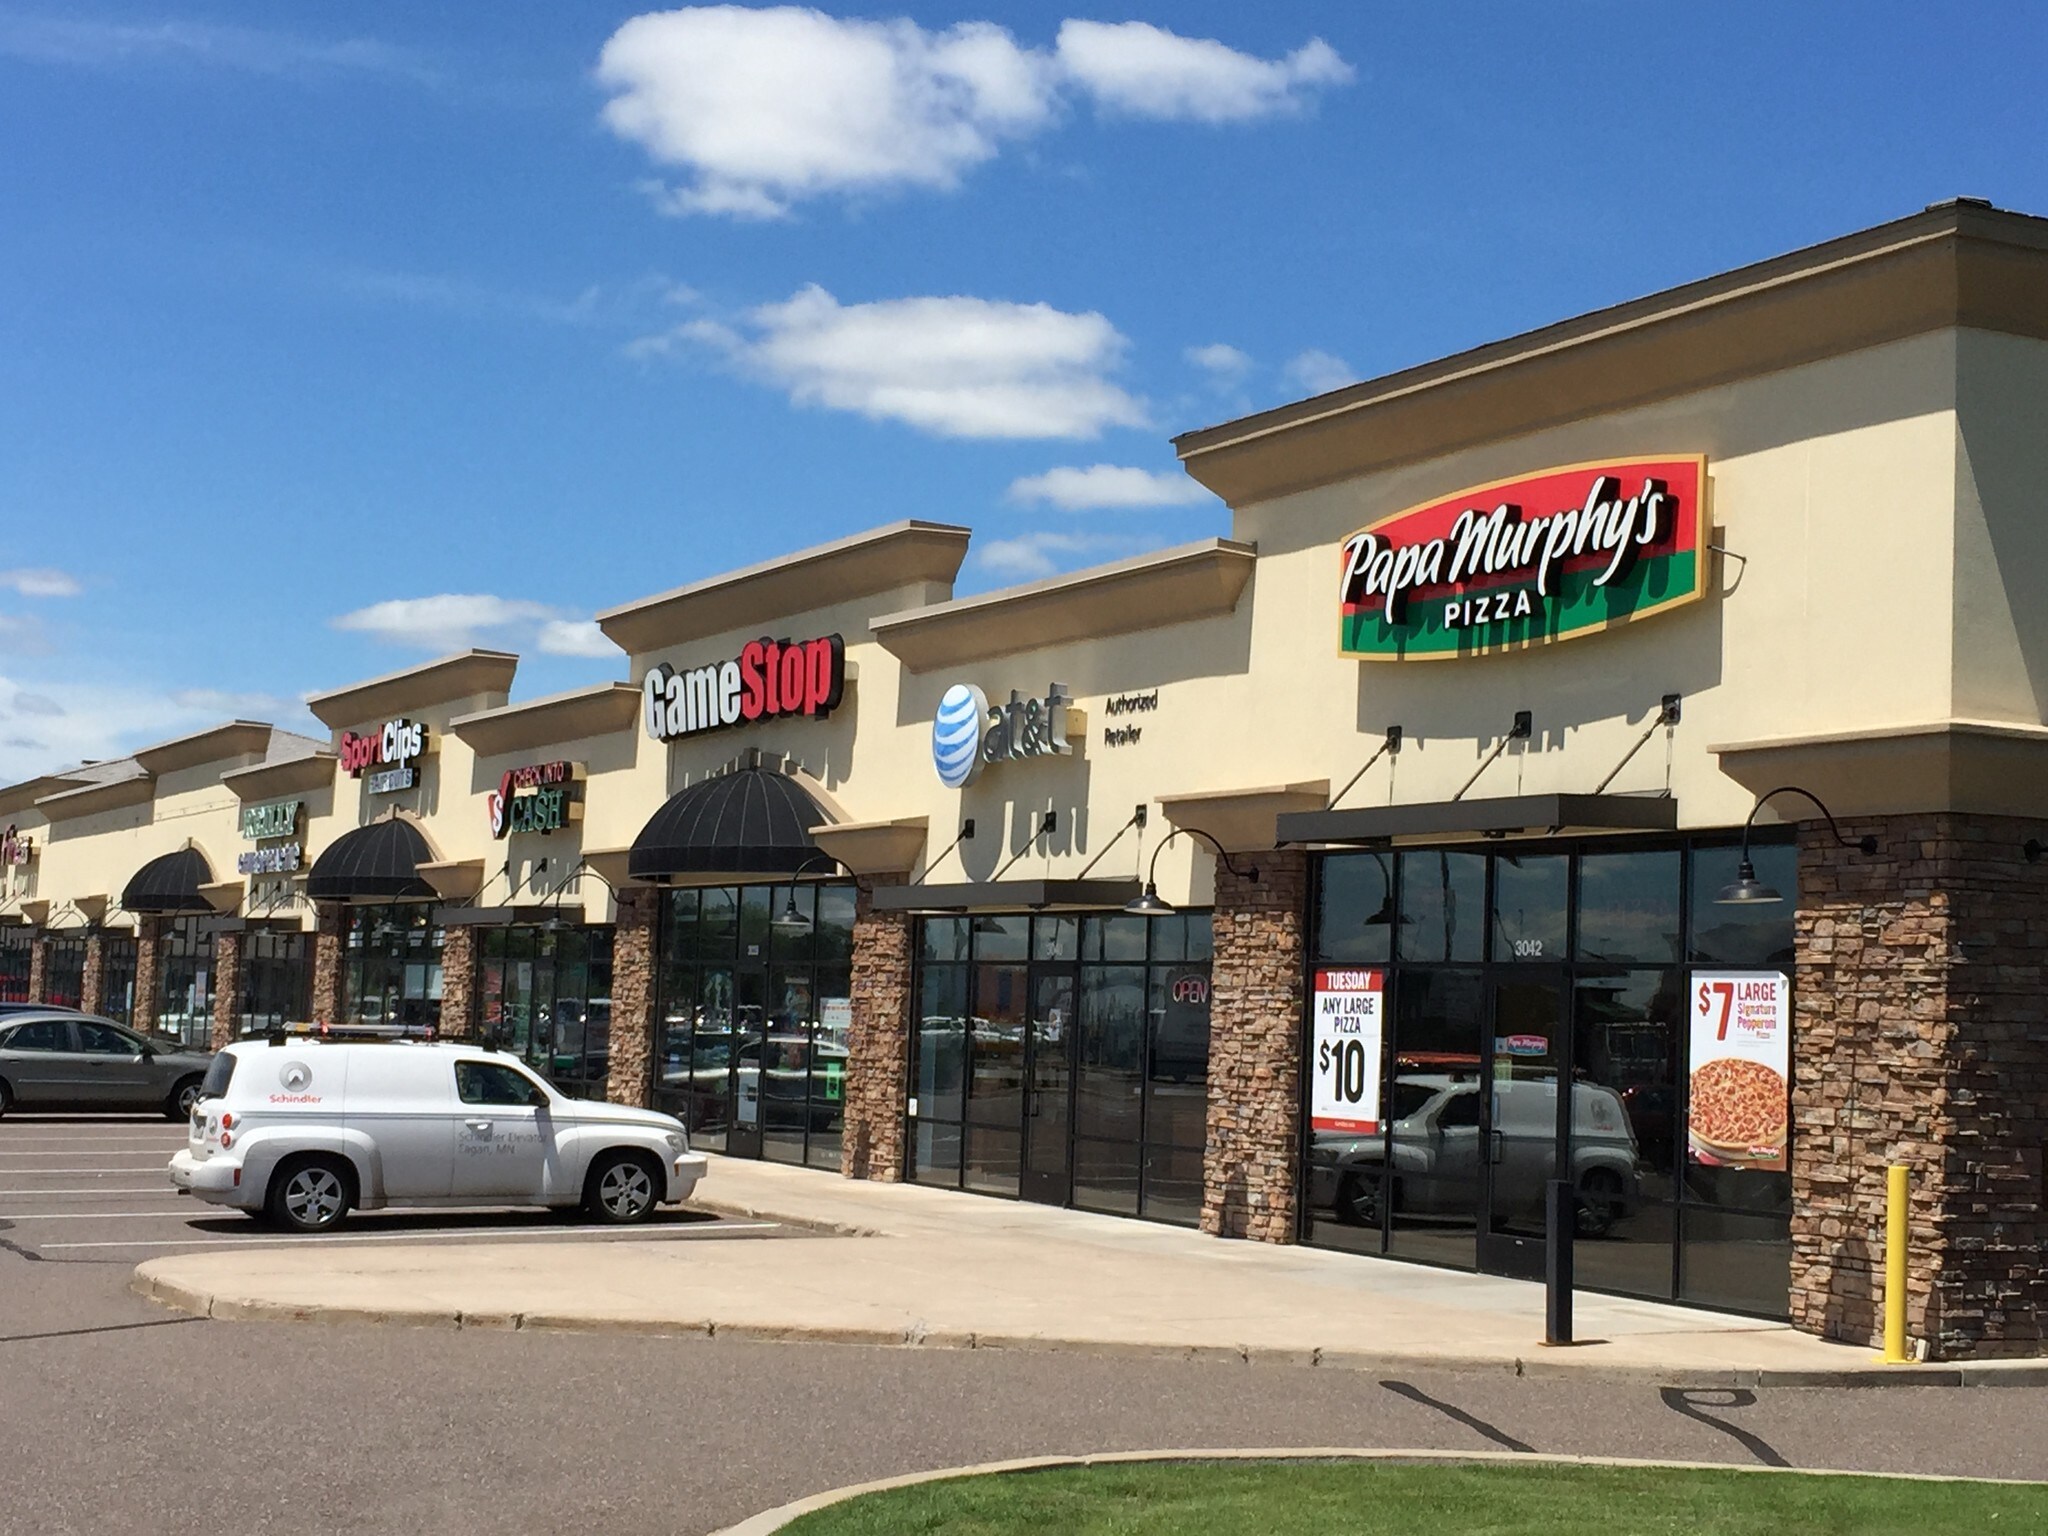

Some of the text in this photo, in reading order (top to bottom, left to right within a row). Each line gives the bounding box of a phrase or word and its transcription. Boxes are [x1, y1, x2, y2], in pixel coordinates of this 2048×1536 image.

[1340, 476, 1664, 624] Papa Murphy's
[1444, 589, 1531, 629] PIZZA
[644, 636, 832, 740] GameStop
[1105, 689, 1158, 716] Authorized
[983, 682, 1070, 763] at&t
[1104, 723, 1142, 748] Retailer
[514, 761, 564, 789] CHECK INTO
[1515, 939, 1543, 956] 3042
[1173, 980, 1208, 1004] OPEN
[1327, 972, 1371, 990] TUESDAY
[1737, 982, 1776, 1001] LARGE
[1322, 997, 1374, 1014] ANY LARGE
[1699, 982, 1734, 1041] $7
[1737, 1002, 1776, 1017] Signature
[1334, 1016, 1361, 1033] PIZZA
[1737, 1016, 1776, 1031] Pepperoni
[1319, 1039, 1365, 1103] $10
[269, 1094, 322, 1103] Schindler
[496, 1144, 515, 1154] MN
